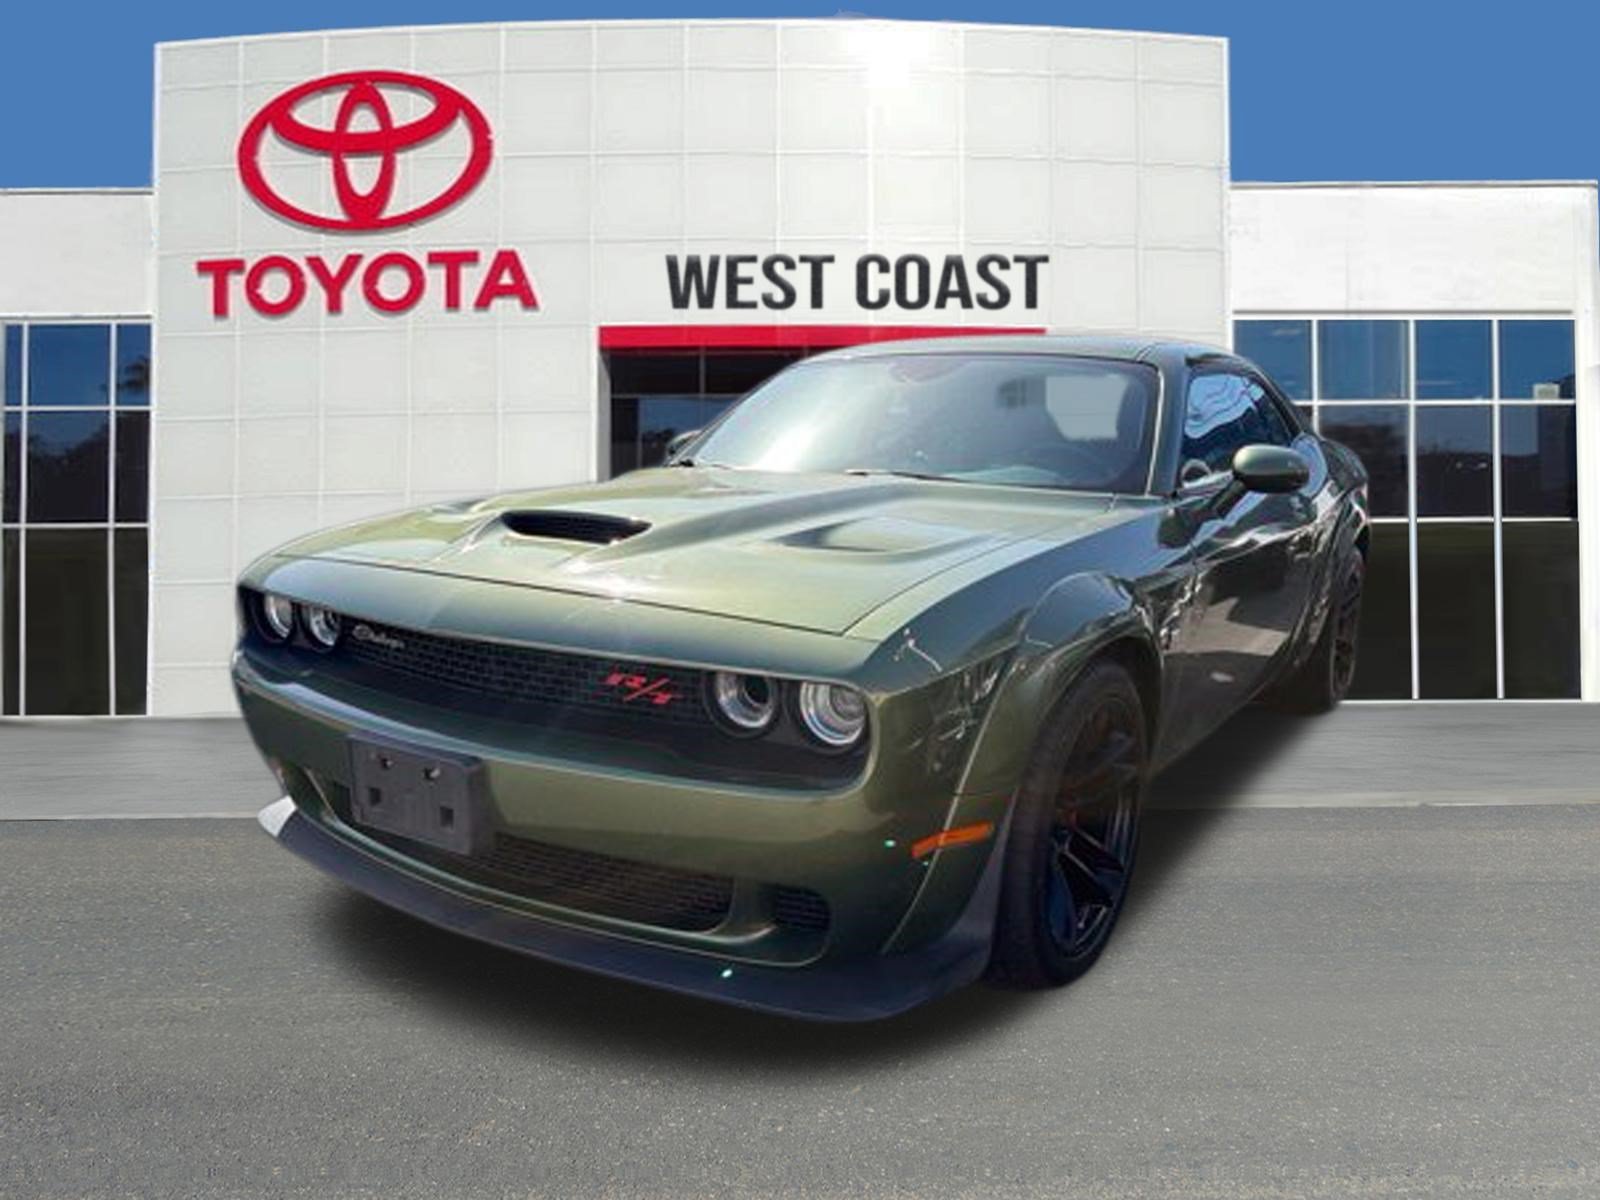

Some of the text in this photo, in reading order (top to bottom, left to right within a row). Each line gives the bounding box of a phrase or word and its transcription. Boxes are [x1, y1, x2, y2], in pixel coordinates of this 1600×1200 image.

[196, 249, 538, 318] TOYOTA
[666, 255, 1049, 310] WEST COAST
